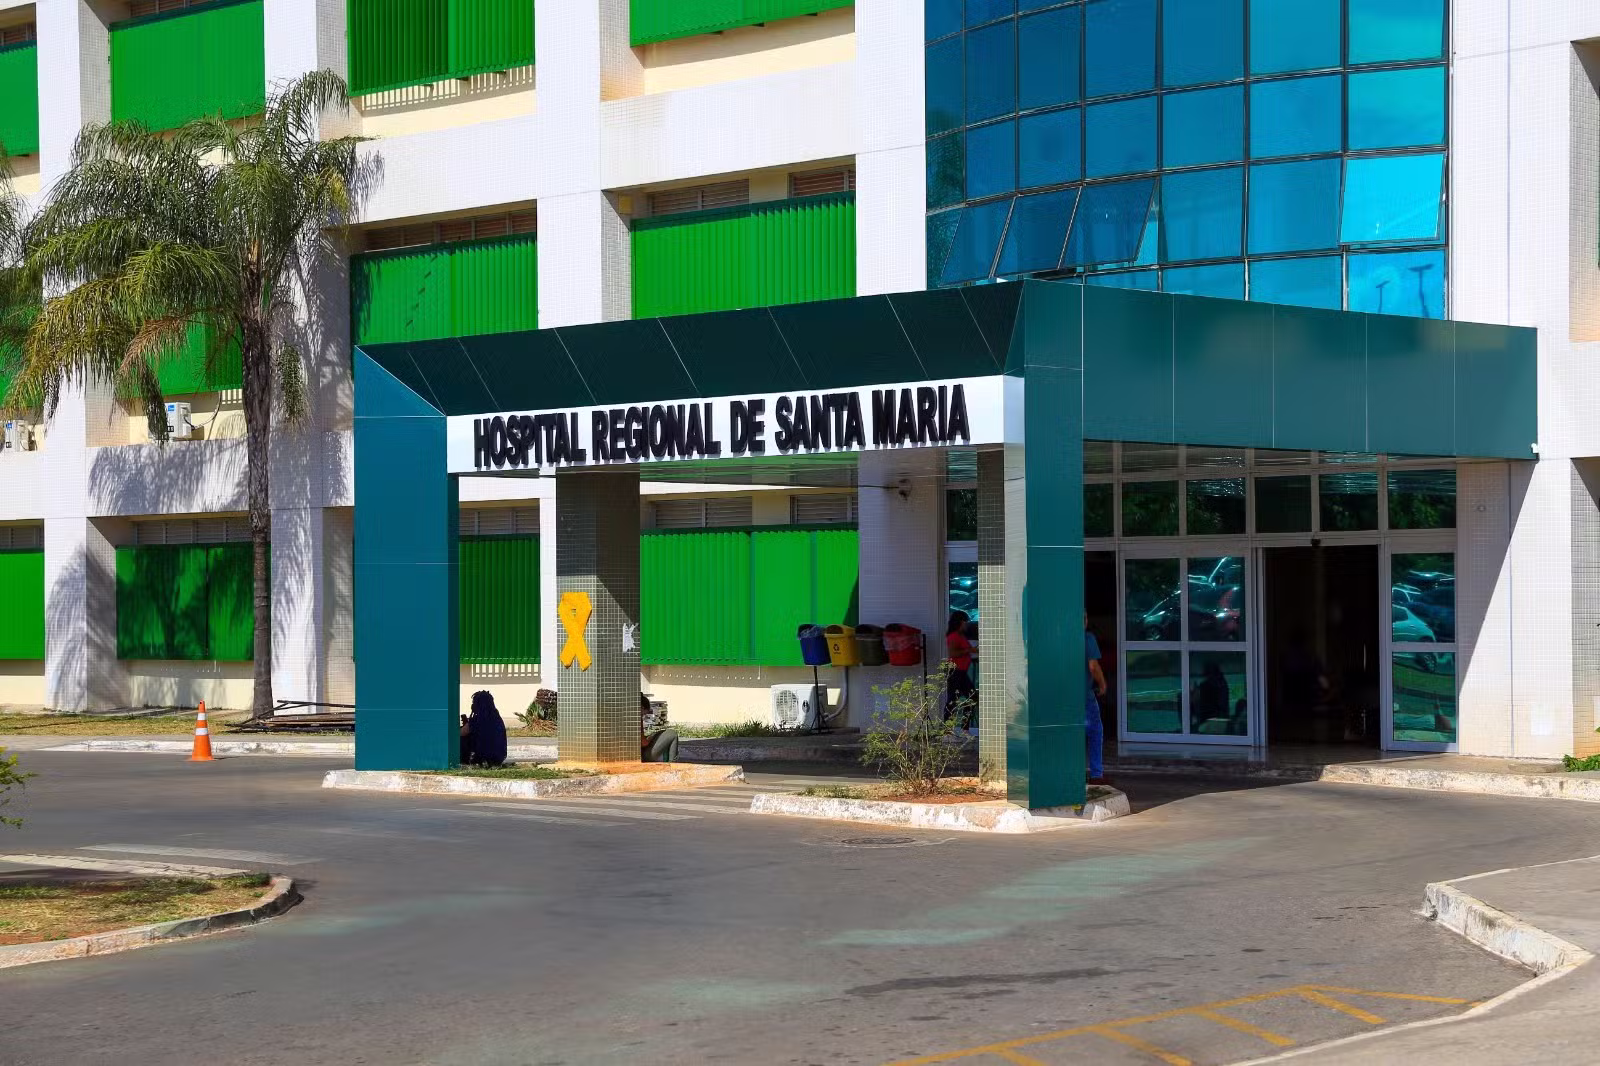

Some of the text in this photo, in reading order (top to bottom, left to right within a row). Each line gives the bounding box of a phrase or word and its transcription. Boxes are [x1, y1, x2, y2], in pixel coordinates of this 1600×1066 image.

[474, 384, 970, 468] HOSPITAL REGIONAL DE SANTA MARIA
